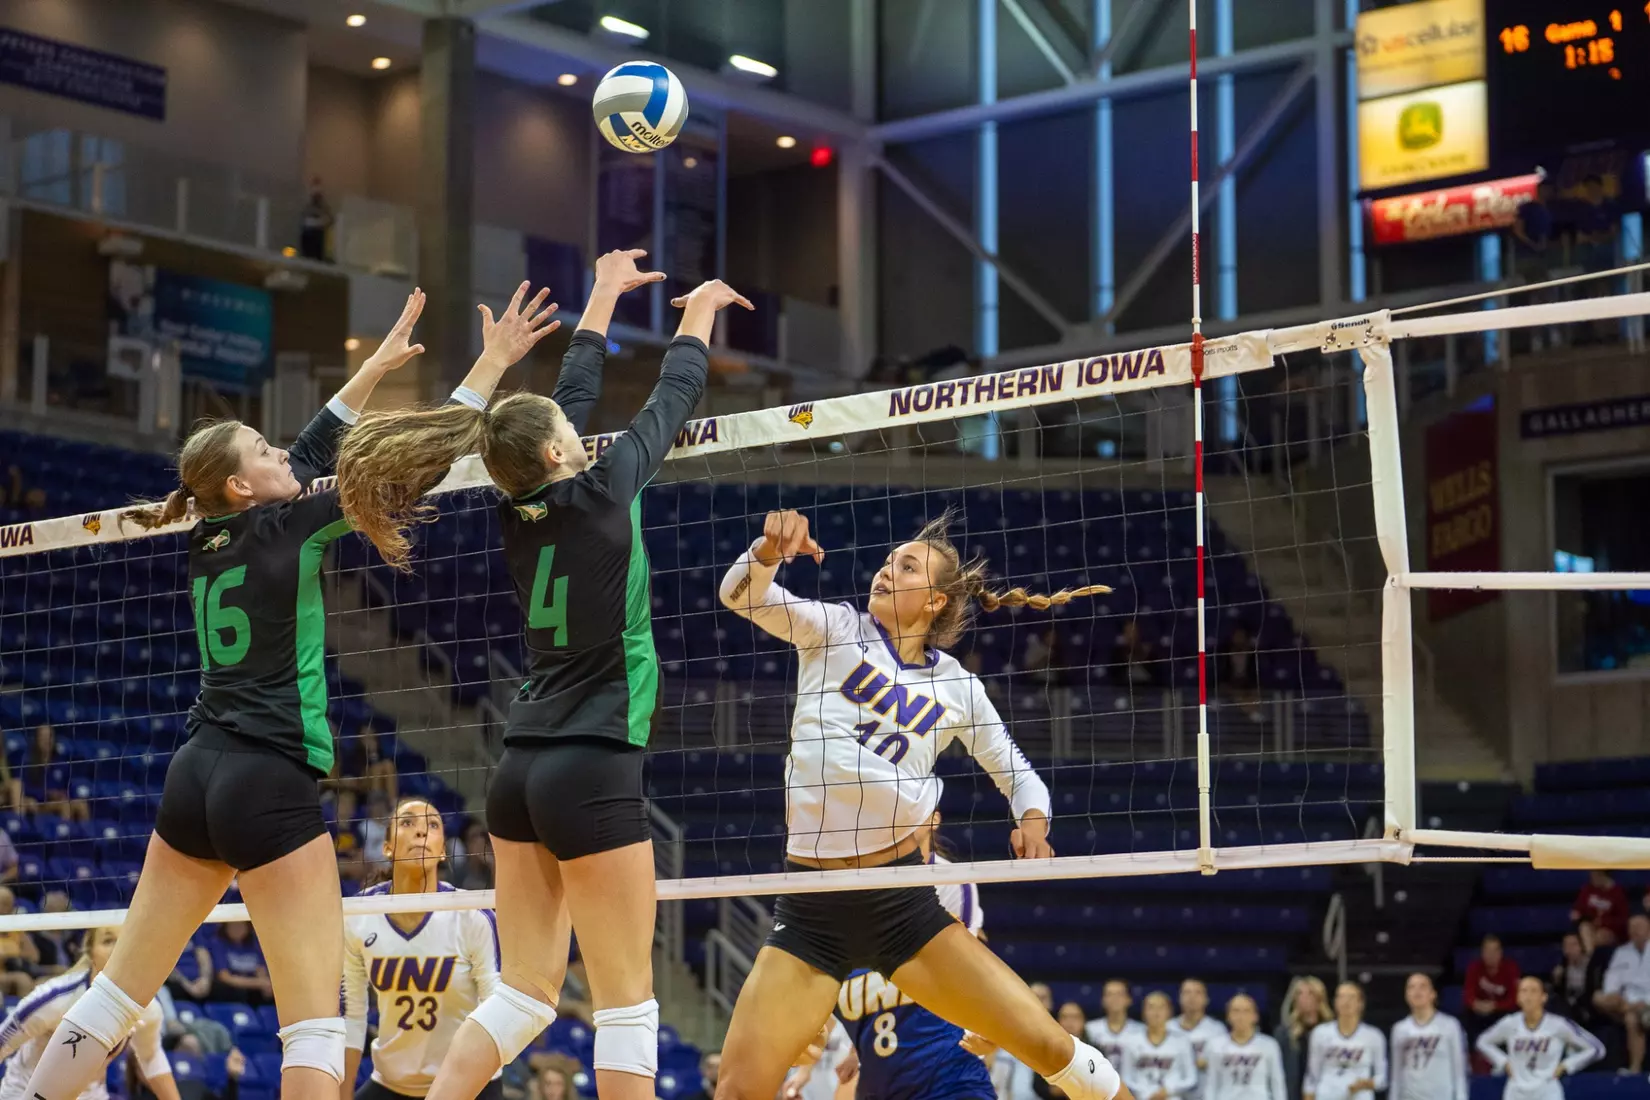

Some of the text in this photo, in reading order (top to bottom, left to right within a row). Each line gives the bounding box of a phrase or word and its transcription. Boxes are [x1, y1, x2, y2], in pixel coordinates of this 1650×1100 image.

[1338, 318, 1370, 329] Senoh
[889, 350, 1166, 417] NORTHERN IOWA
[788, 403, 814, 419] UNI
[83, 513, 101, 526] UNI
[528, 544, 569, 647] 4
[193, 564, 252, 671] 16
[839, 660, 948, 739] UNI
[370, 955, 458, 993] UNI
[394, 994, 439, 1032] 23
[873, 1011, 899, 1058] 8
[1514, 1037, 1550, 1052] UNI
